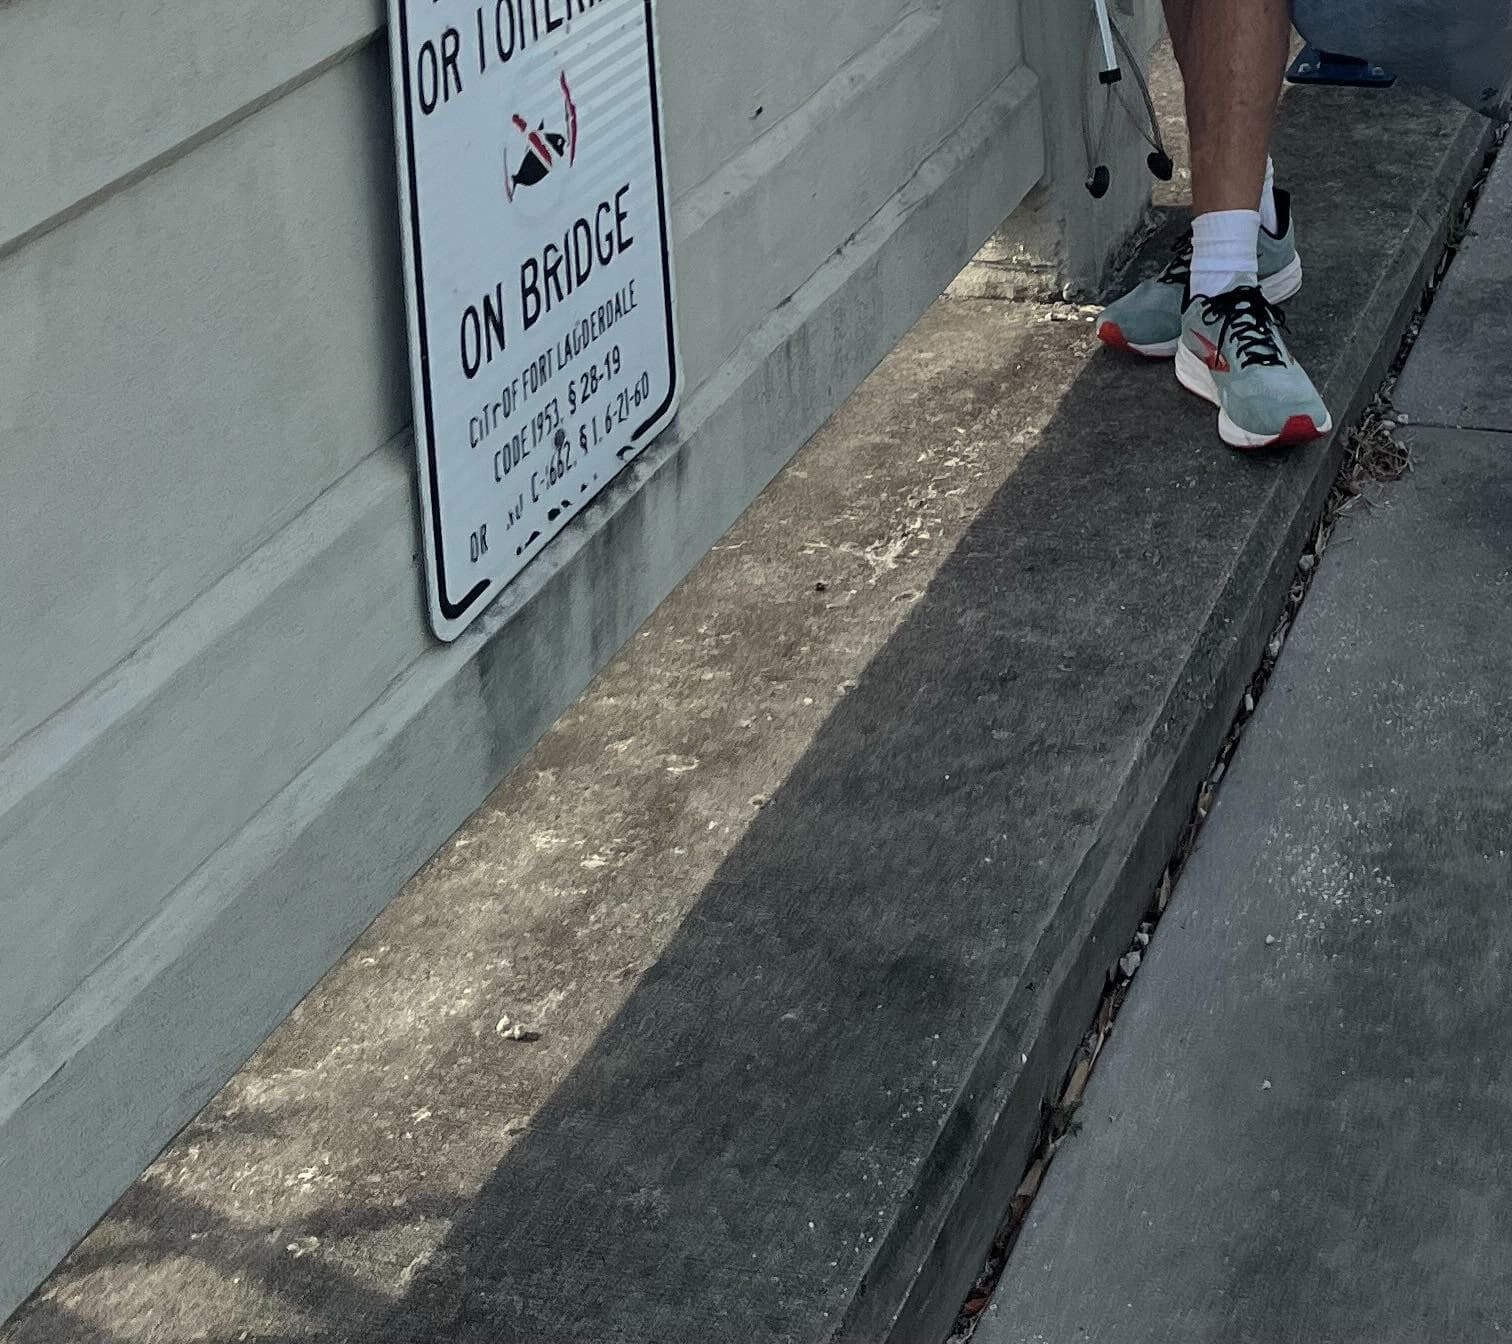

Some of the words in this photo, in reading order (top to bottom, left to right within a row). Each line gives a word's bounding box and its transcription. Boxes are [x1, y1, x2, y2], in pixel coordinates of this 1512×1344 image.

[417, 27, 463, 116] OR
[461, 281, 506, 380] ON
[520, 183, 634, 331] BRIDGE
[502, 378, 520, 419] OF
[522, 348, 553, 401] FORT
[557, 278, 638, 371] LAUDERDALE
[494, 425, 531, 483] CODE
[580, 345, 621, 404] 28-19
[605, 371, 650, 434] 6-21-60
